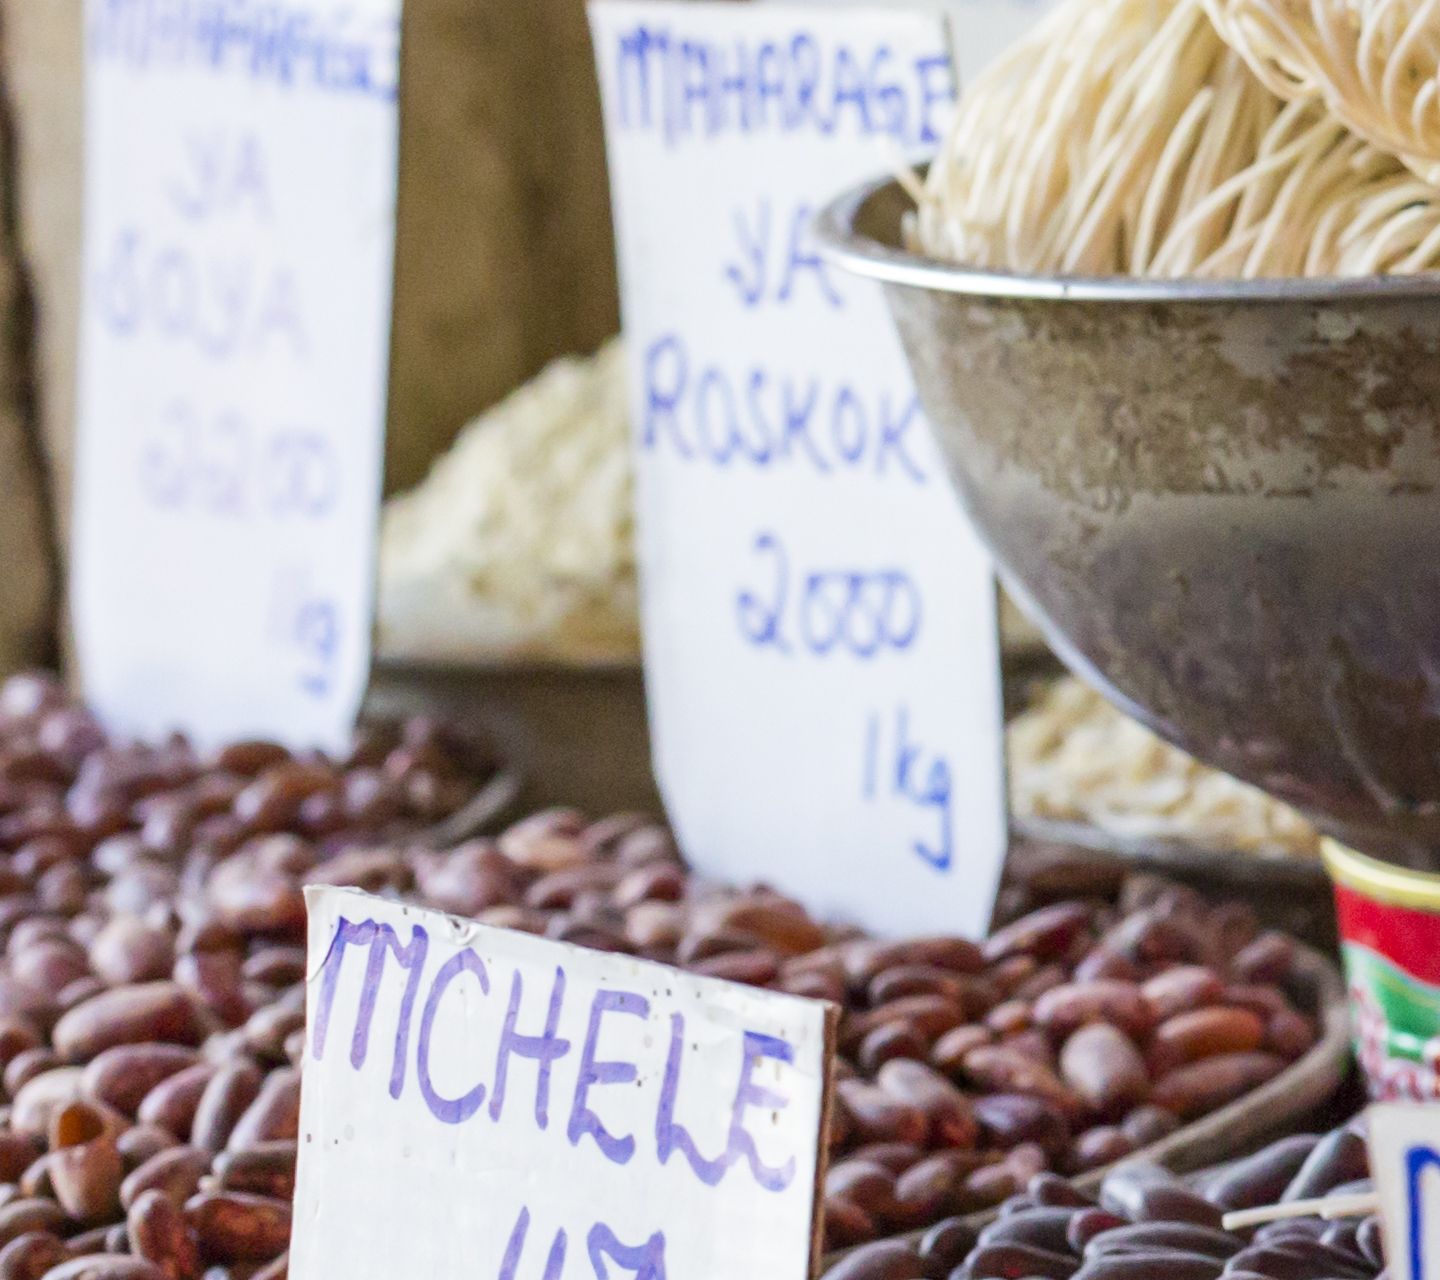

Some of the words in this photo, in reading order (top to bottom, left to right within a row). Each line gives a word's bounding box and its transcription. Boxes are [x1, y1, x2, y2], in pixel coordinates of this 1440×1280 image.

[616, 26, 953, 148] MAHARAGE
[727, 200, 844, 308] YA
[737, 534, 924, 654] 2000
[863, 712, 953, 872] 1kg
[314, 917, 795, 1191] MCHELE
